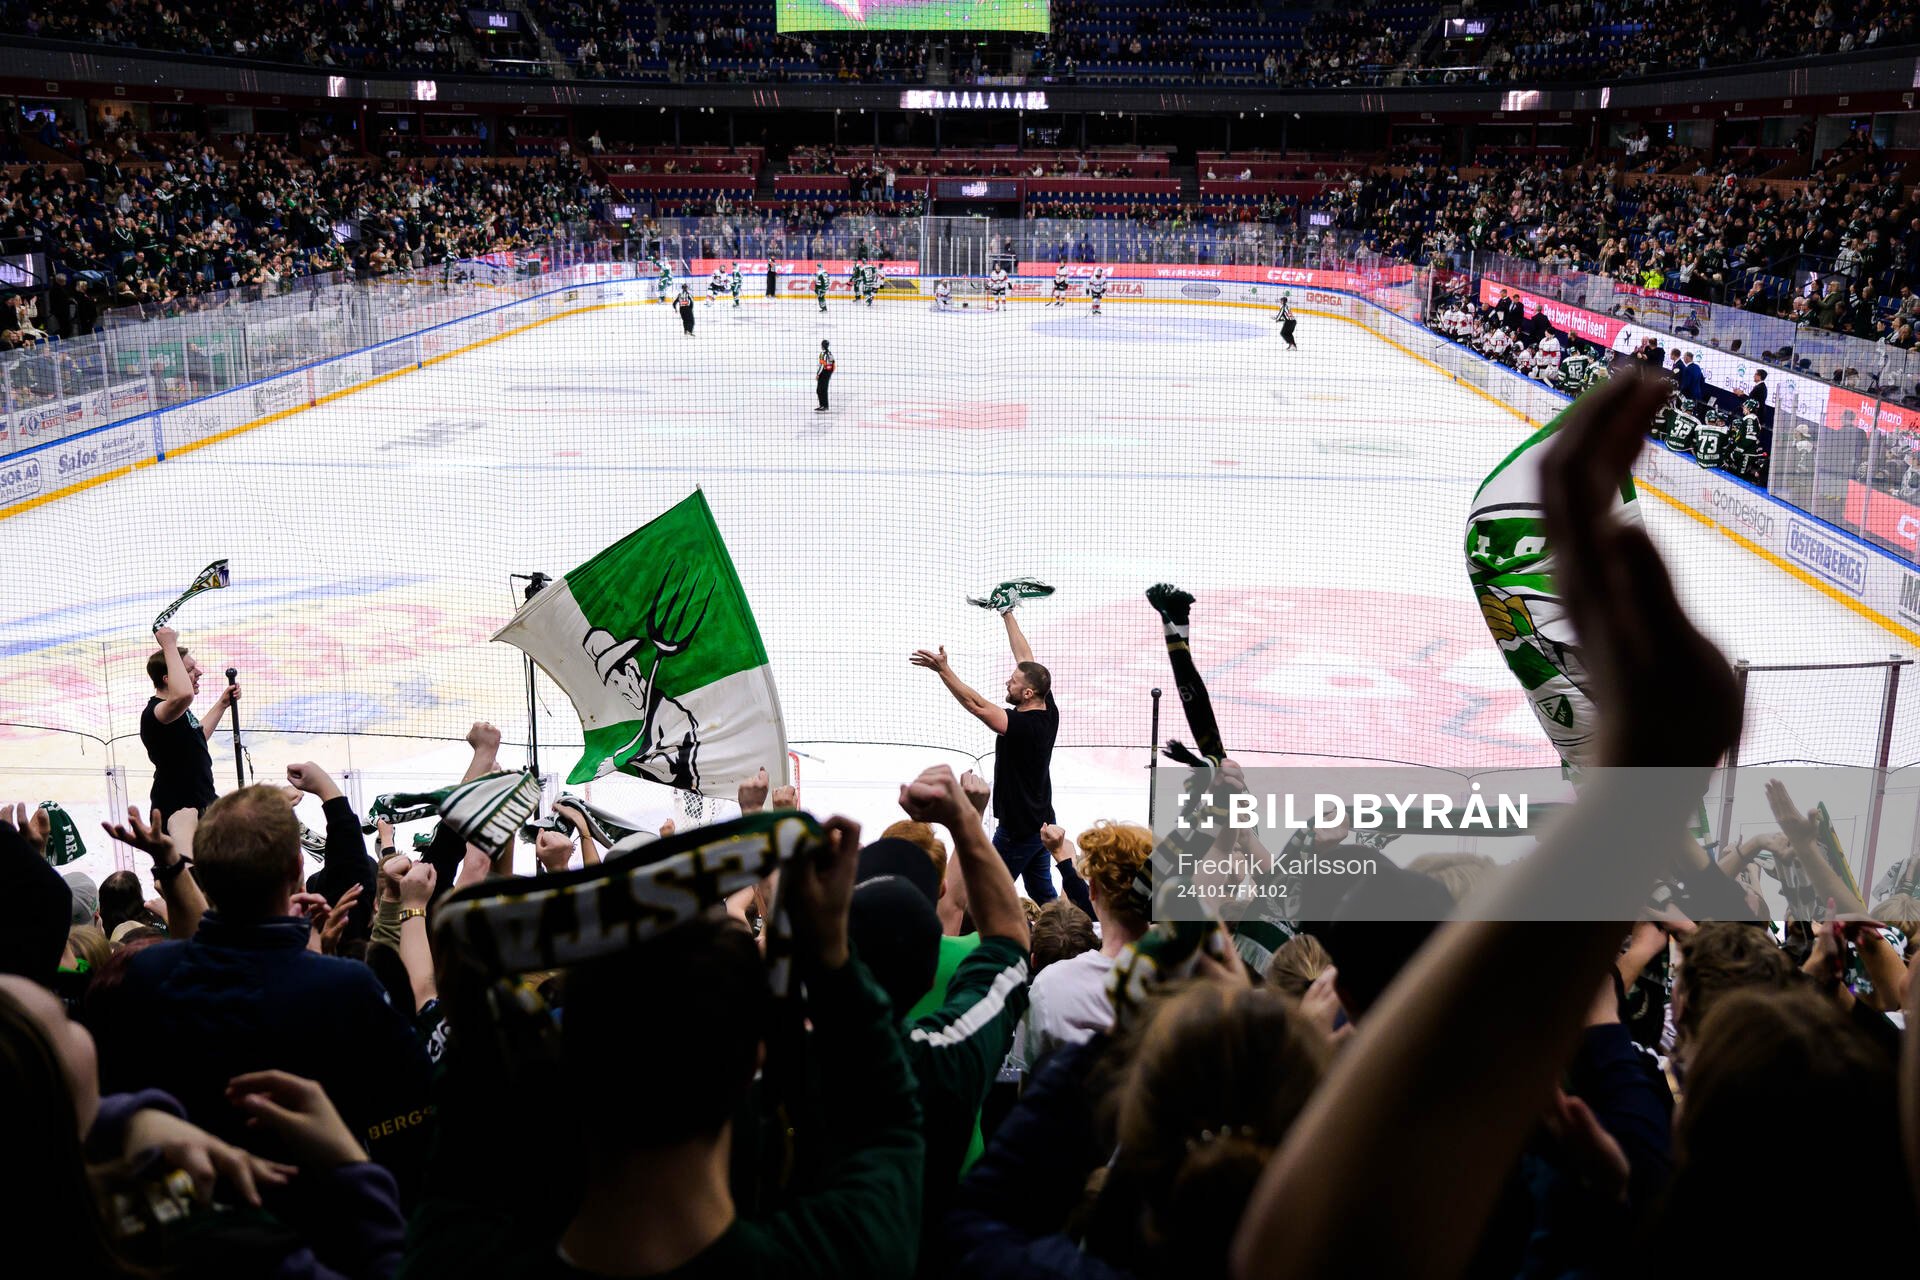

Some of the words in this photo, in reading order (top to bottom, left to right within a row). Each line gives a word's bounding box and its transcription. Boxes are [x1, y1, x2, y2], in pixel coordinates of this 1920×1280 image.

[1267, 270, 1313, 283] CCM
[1107, 284, 1143, 295] JULA
[1698, 435, 1718, 453] 73
[58, 448, 98, 475] Salos
[1790, 525, 1863, 585] ÖSTERBERGS
